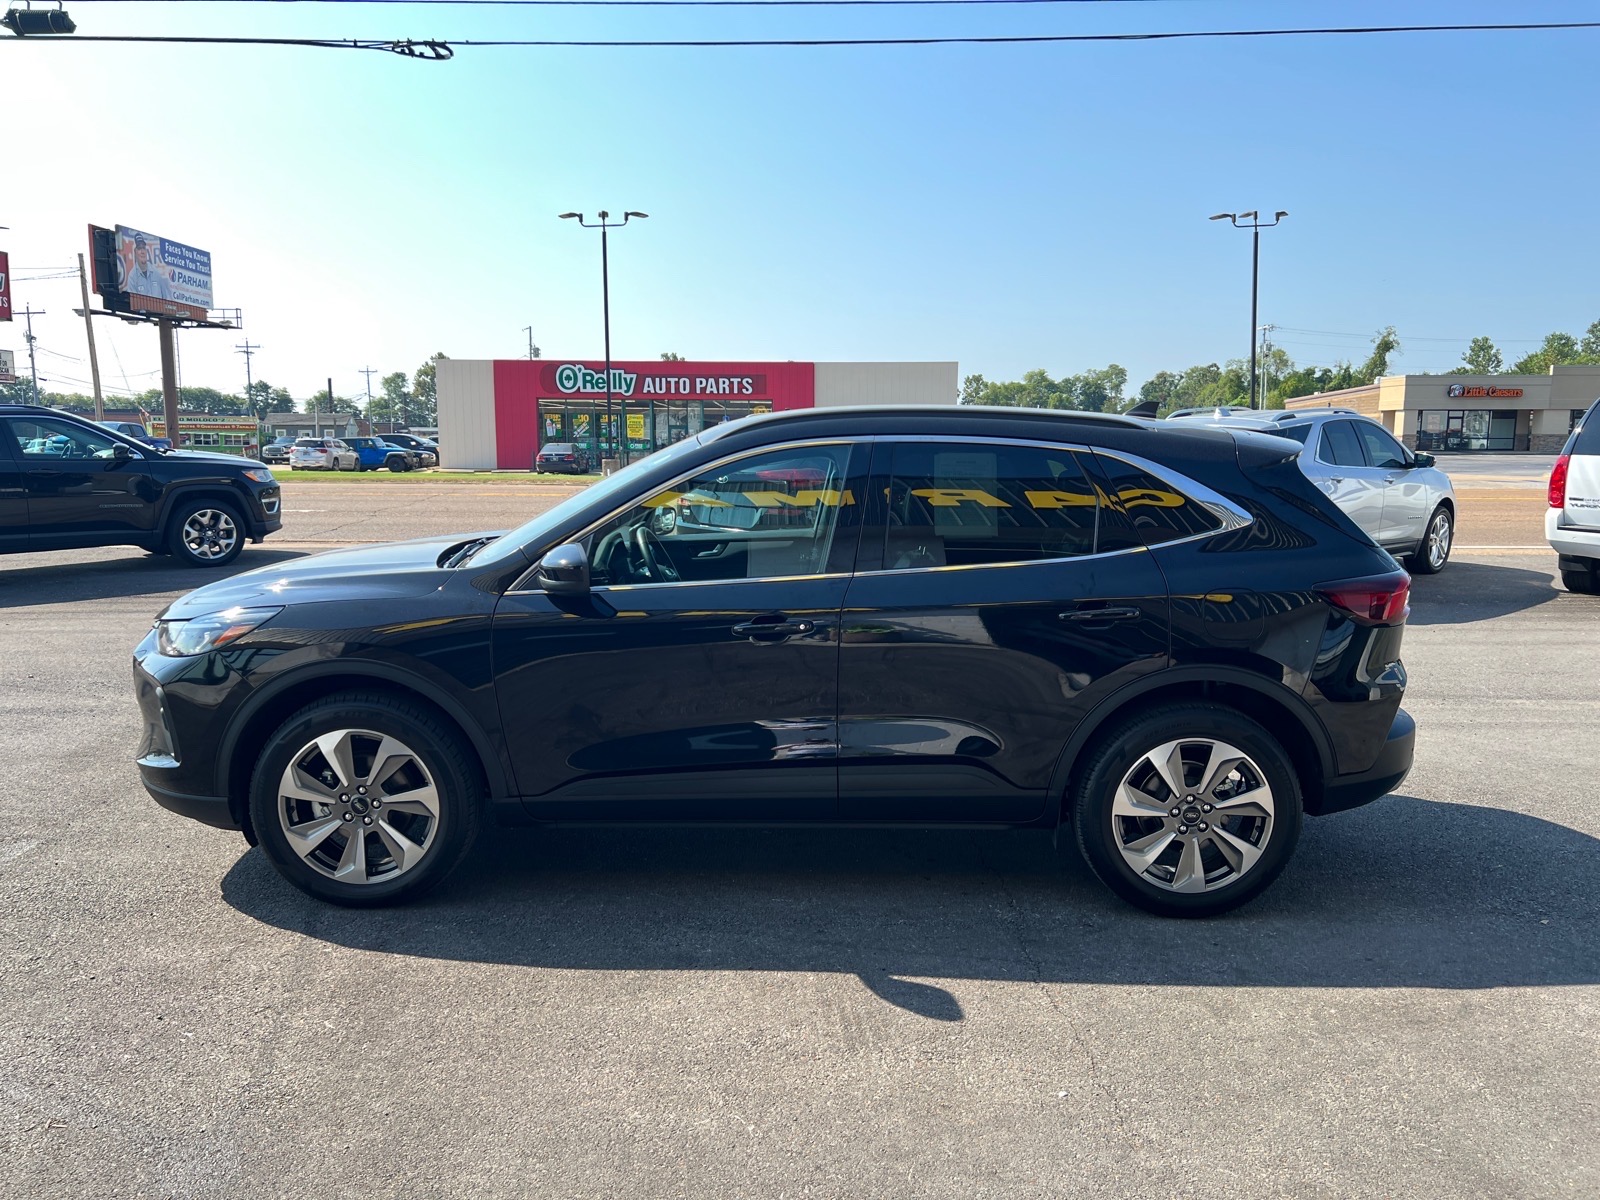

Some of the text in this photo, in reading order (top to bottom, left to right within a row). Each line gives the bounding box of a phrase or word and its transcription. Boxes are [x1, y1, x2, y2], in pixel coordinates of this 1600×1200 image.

[165, 242, 181, 255] Faces
[181, 247, 192, 259] You
[193, 251, 210, 264] Know.
[164, 253, 185, 267] Service
[186, 258, 196, 270] You
[196, 262, 211, 274] Trust.
[177, 271, 208, 290] PARHAM
[172, 291, 210, 307] CallParham.com
[557, 365, 753, 395] O'Relly AUTO PARTS
[1463, 385, 1523, 397] Little Caesars
